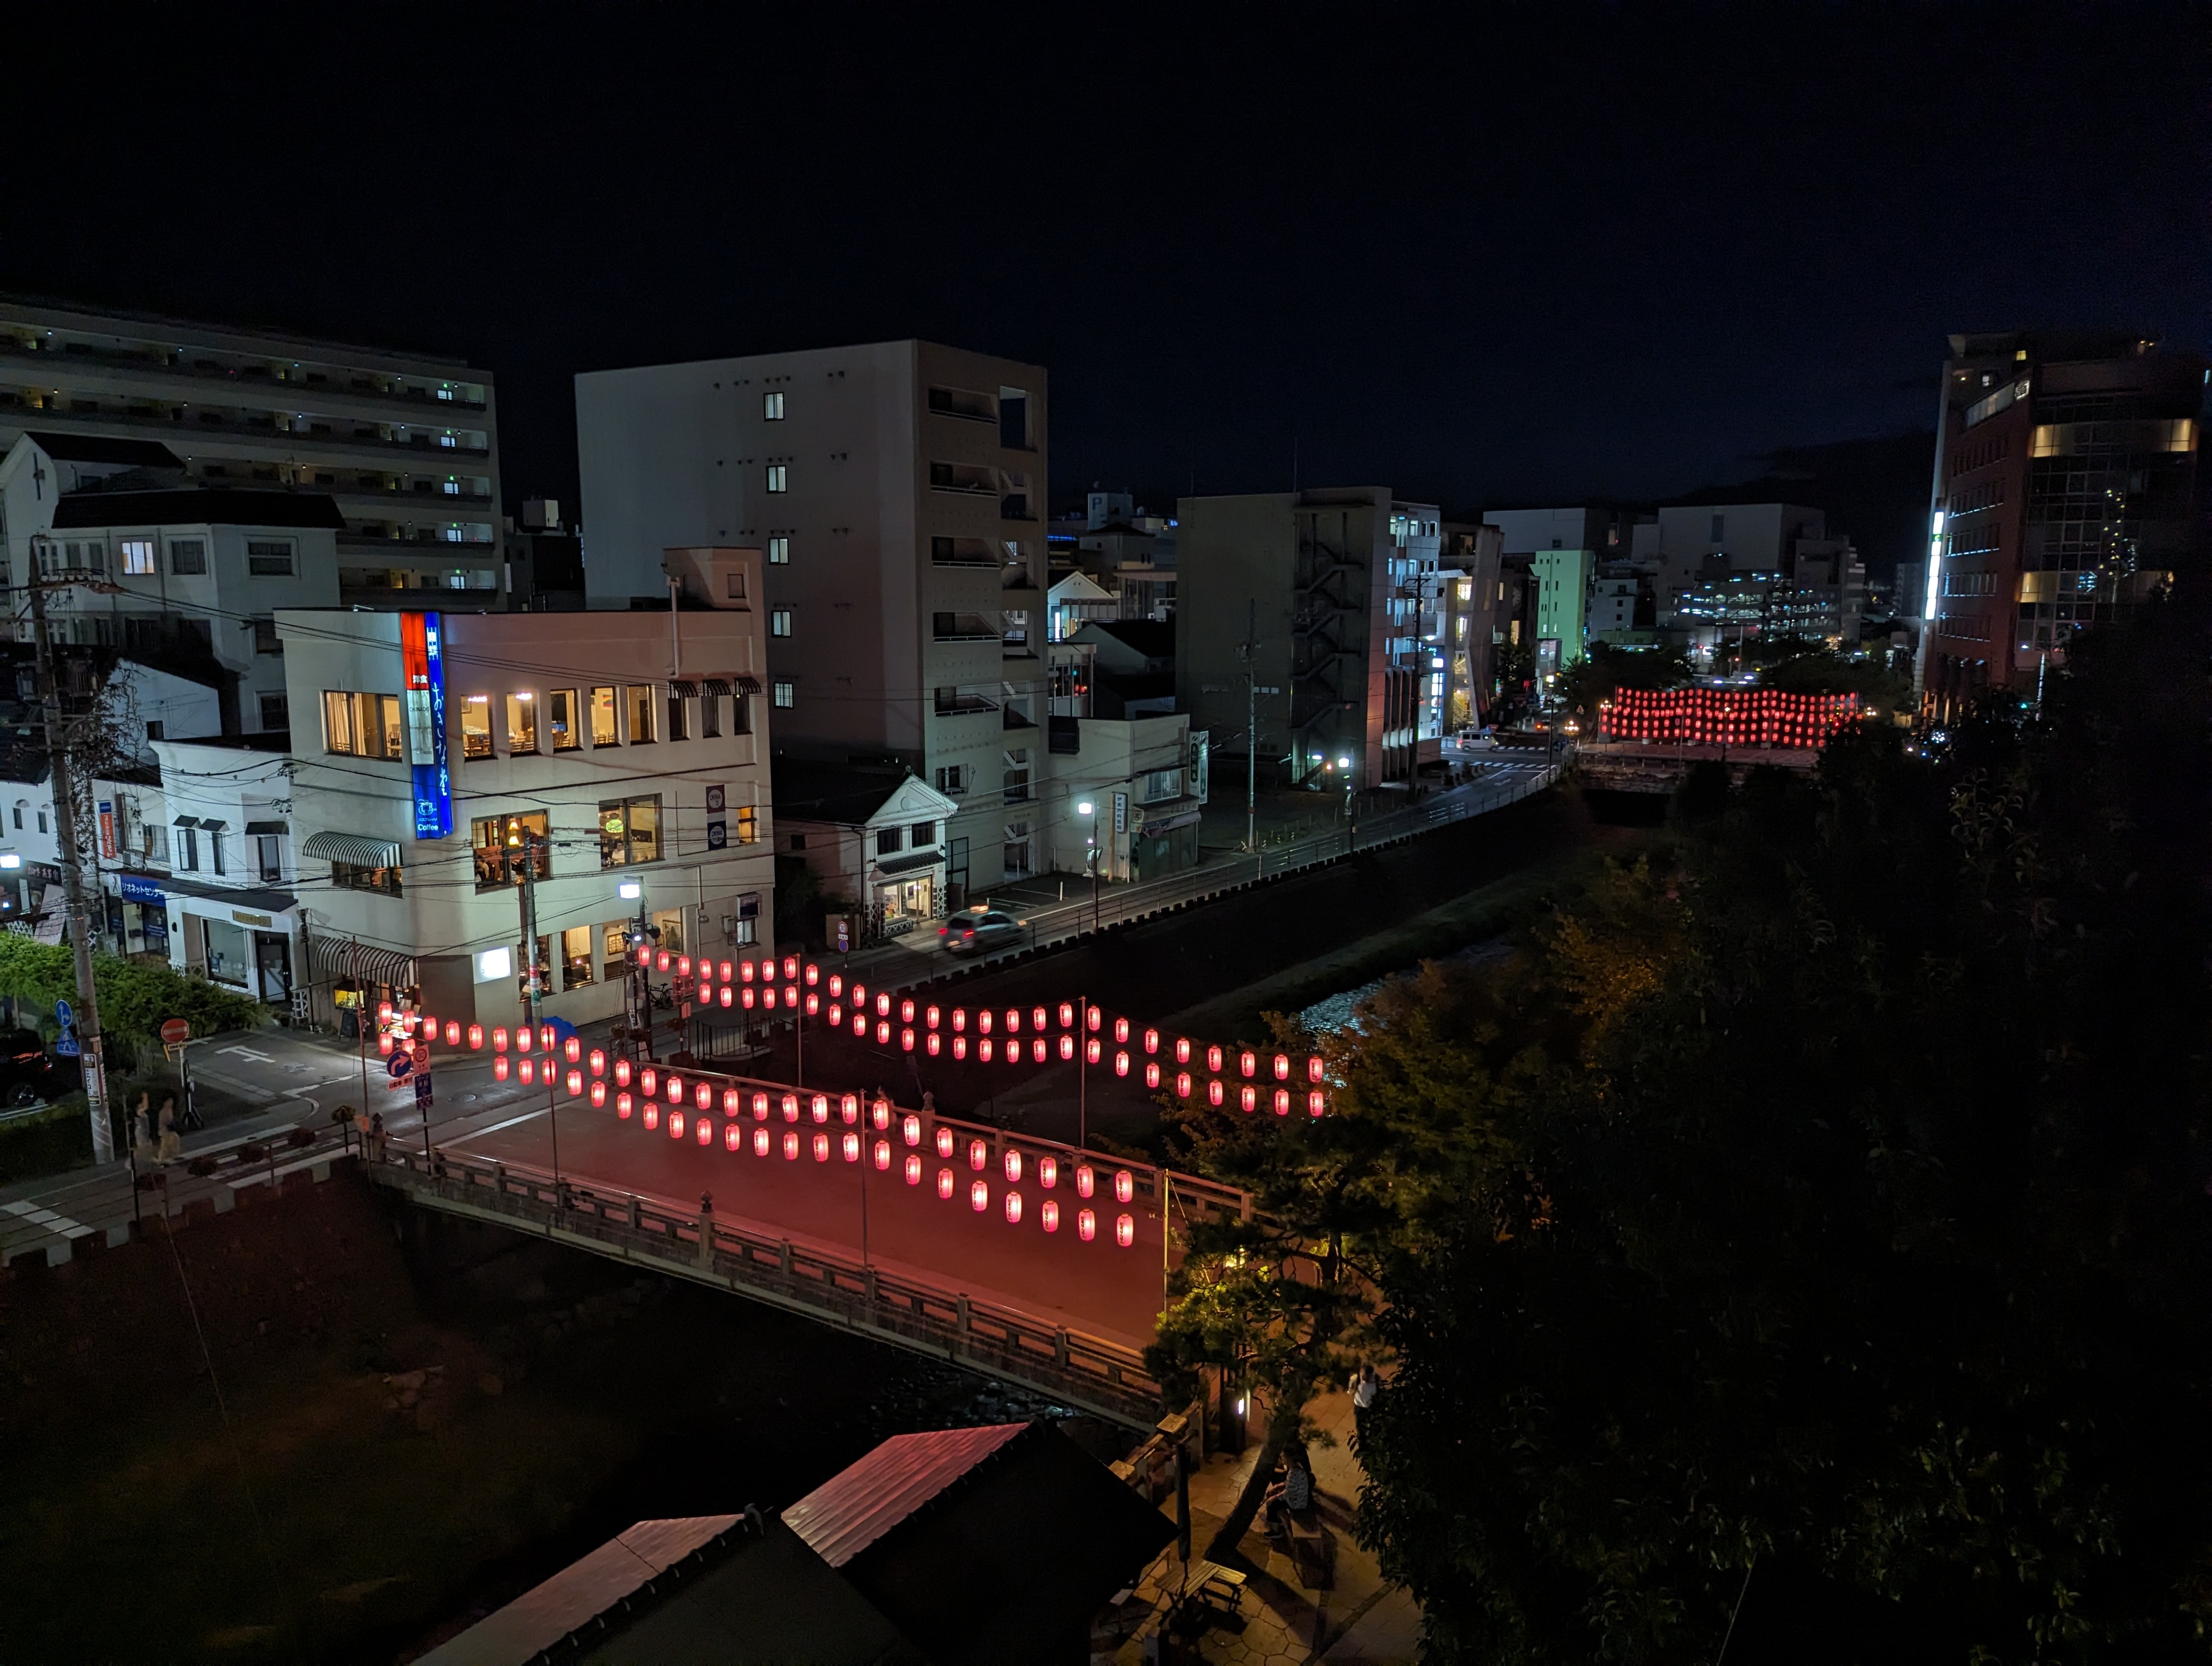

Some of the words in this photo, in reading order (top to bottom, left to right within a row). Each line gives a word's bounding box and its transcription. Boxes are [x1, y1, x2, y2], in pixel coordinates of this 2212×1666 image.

[413, 674, 428, 683] 洋食
[121, 882, 165, 898] リオネットセンター
[389, 1077, 413, 1089] 自動車・原付
